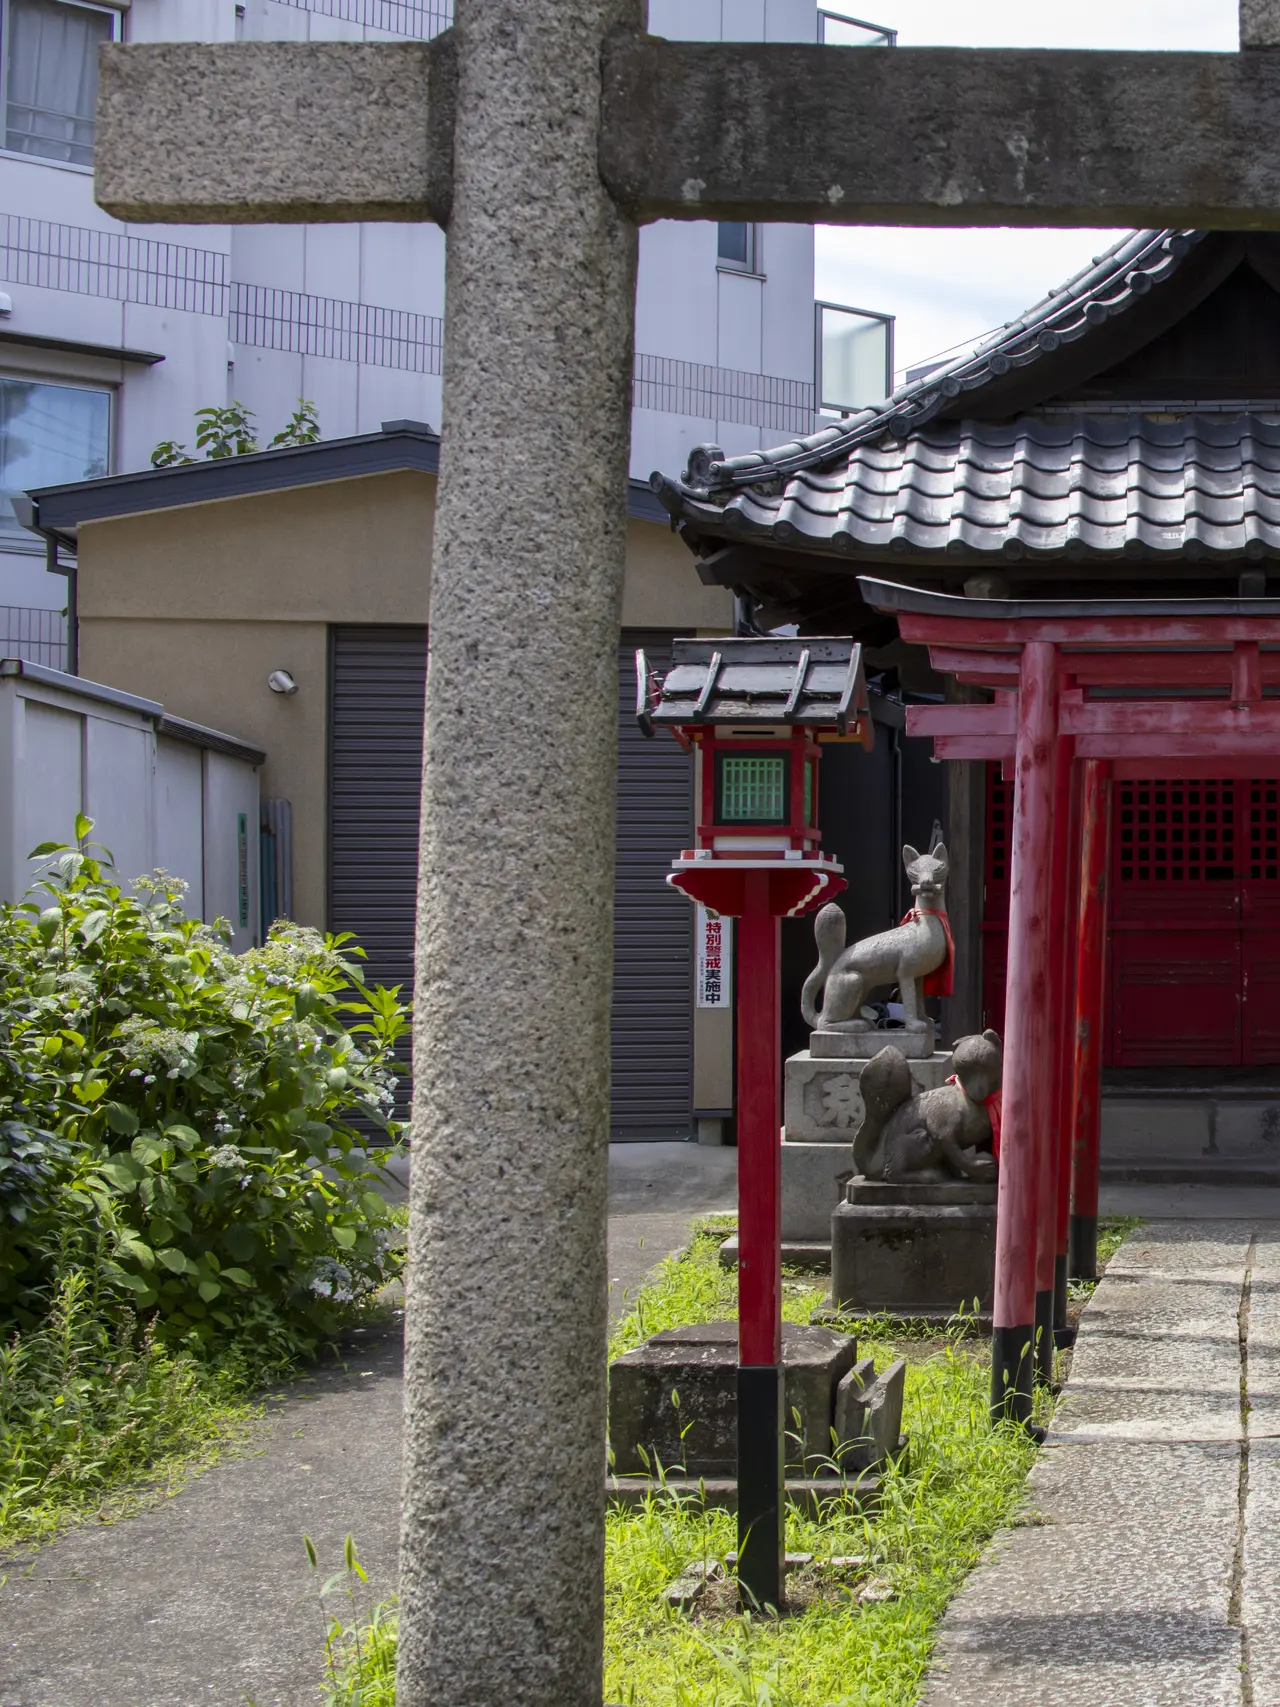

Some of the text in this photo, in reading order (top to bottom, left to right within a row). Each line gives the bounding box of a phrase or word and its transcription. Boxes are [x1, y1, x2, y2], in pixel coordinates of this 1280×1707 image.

[705, 922, 722, 1004] 特別警戒実施中
